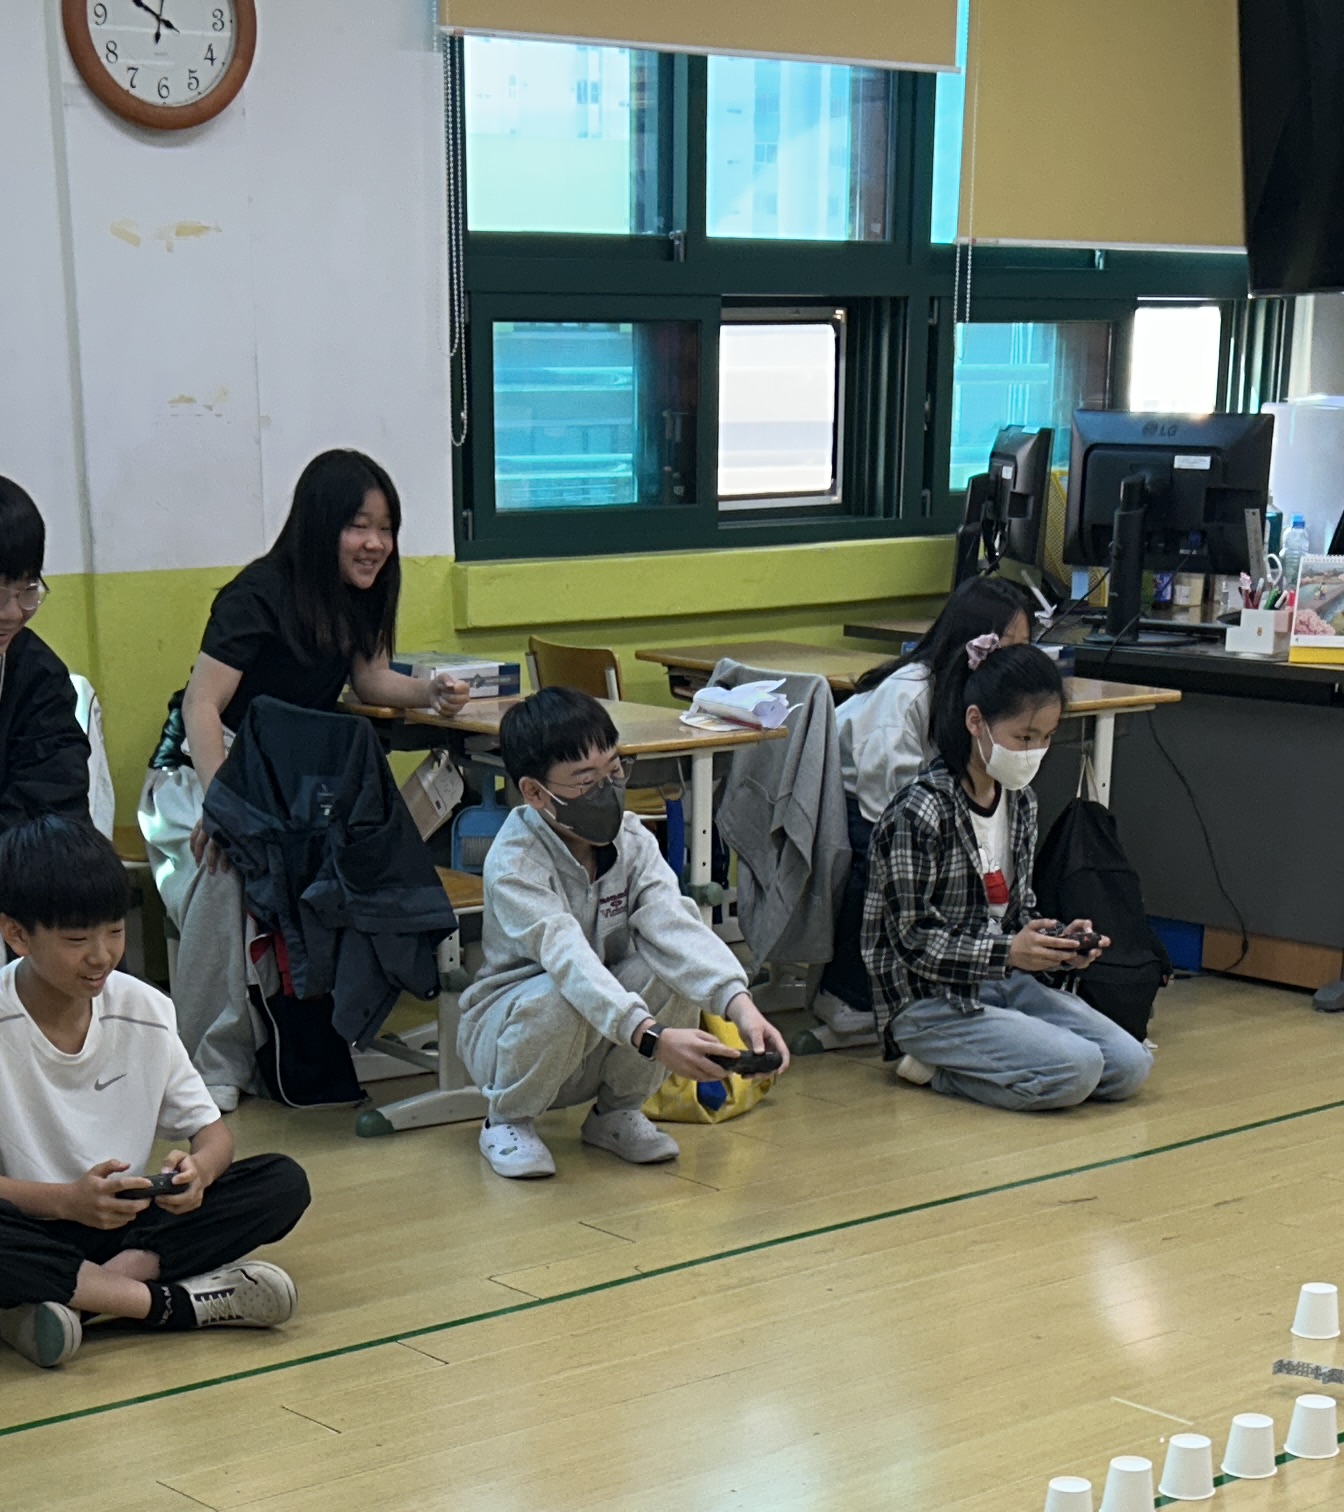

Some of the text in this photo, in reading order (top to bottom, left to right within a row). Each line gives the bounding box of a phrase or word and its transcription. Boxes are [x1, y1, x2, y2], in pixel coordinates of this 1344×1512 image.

[93, 3, 108, 26] 9
[211, 8, 225, 32] 3
[105, 40, 119, 64] 8
[204, 43, 216, 66] 4
[126, 67, 139, 89] 7
[157, 77, 170, 99] 6
[188, 69, 200, 91] 5
[1159, 424, 1178, 438] LG
